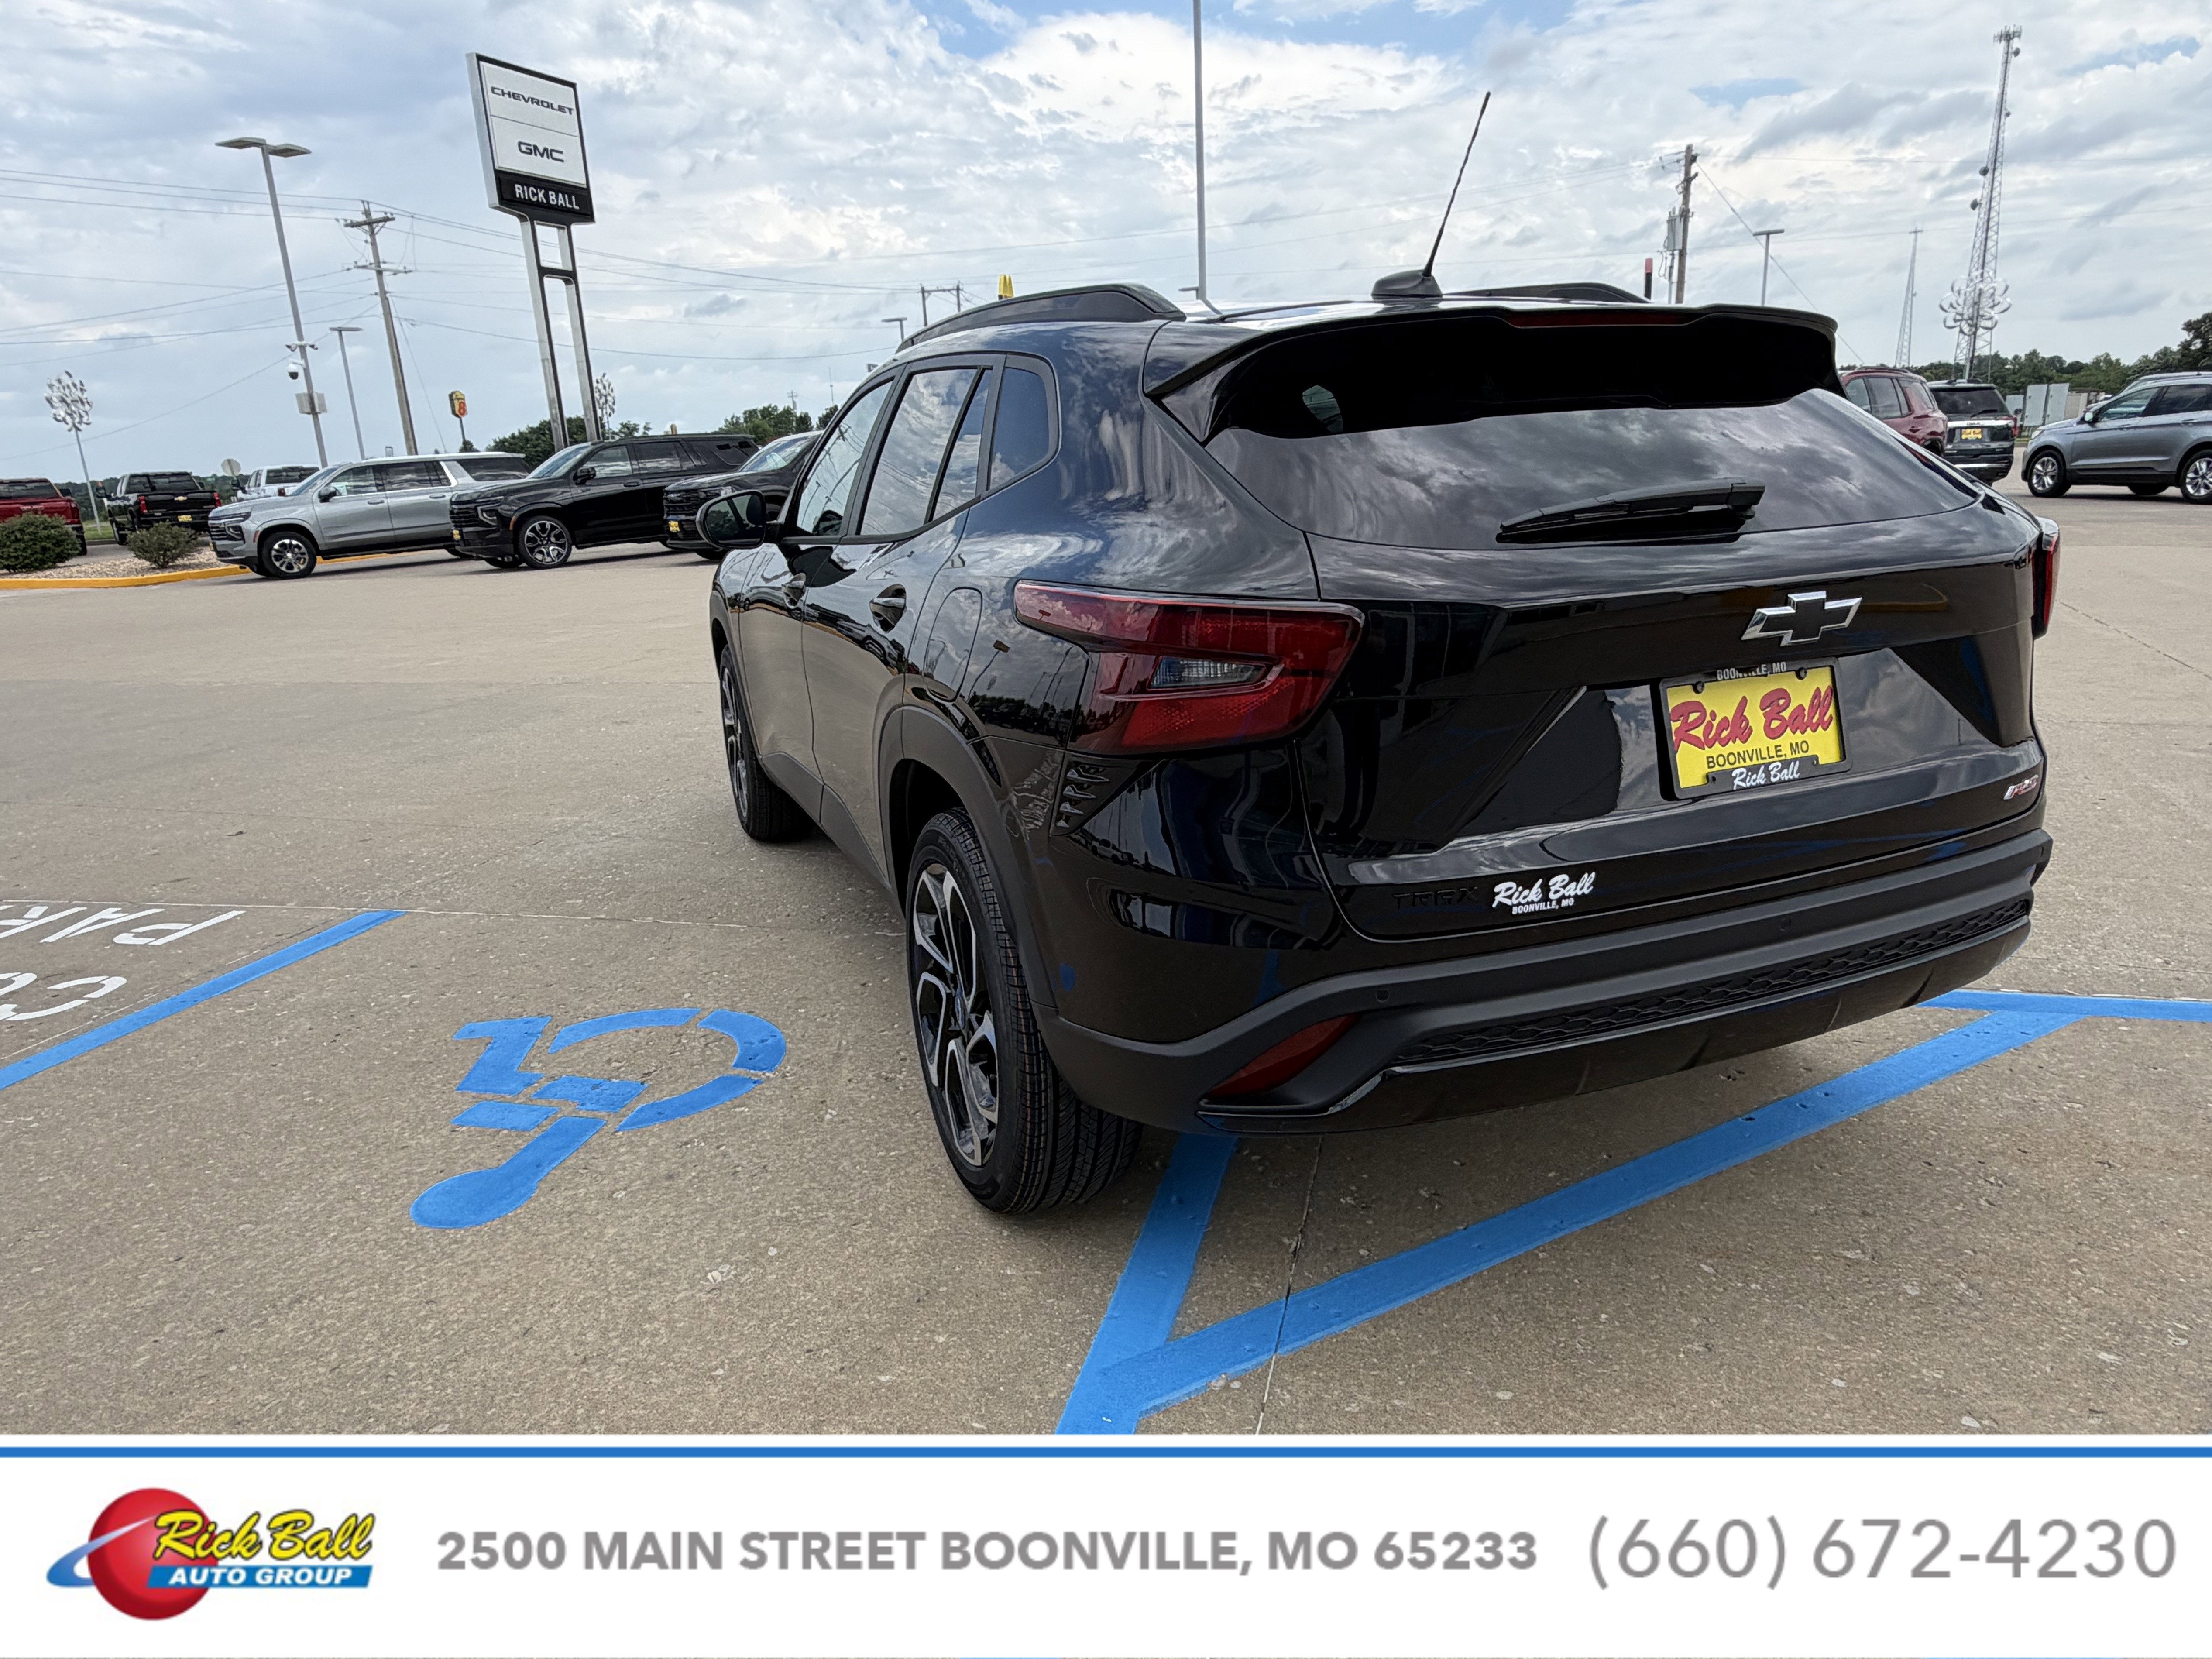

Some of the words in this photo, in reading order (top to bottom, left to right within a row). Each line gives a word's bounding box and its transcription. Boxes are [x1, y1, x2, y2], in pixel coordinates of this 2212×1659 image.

[491, 86, 574, 115] CHEVROLET
[518, 141, 564, 162] GMC
[515, 184, 546, 203] RICK
[549, 191, 579, 210] BALL
[1772, 661, 1787, 673] MO
[1670, 696, 1753, 754] Rick
[1759, 685, 1834, 740] Ball
[1706, 745, 1787, 769] BOONVILLE,
[1790, 740, 1810, 756] MO
[1732, 767, 1767, 790] Rick
[1768, 761, 1800, 783] Ball
[1492, 879, 1543, 908] Rick
[1548, 871, 1596, 900] Ball
[1512, 901, 1559, 915] BOONVILLE,
[1561, 898, 1574, 907] MO
